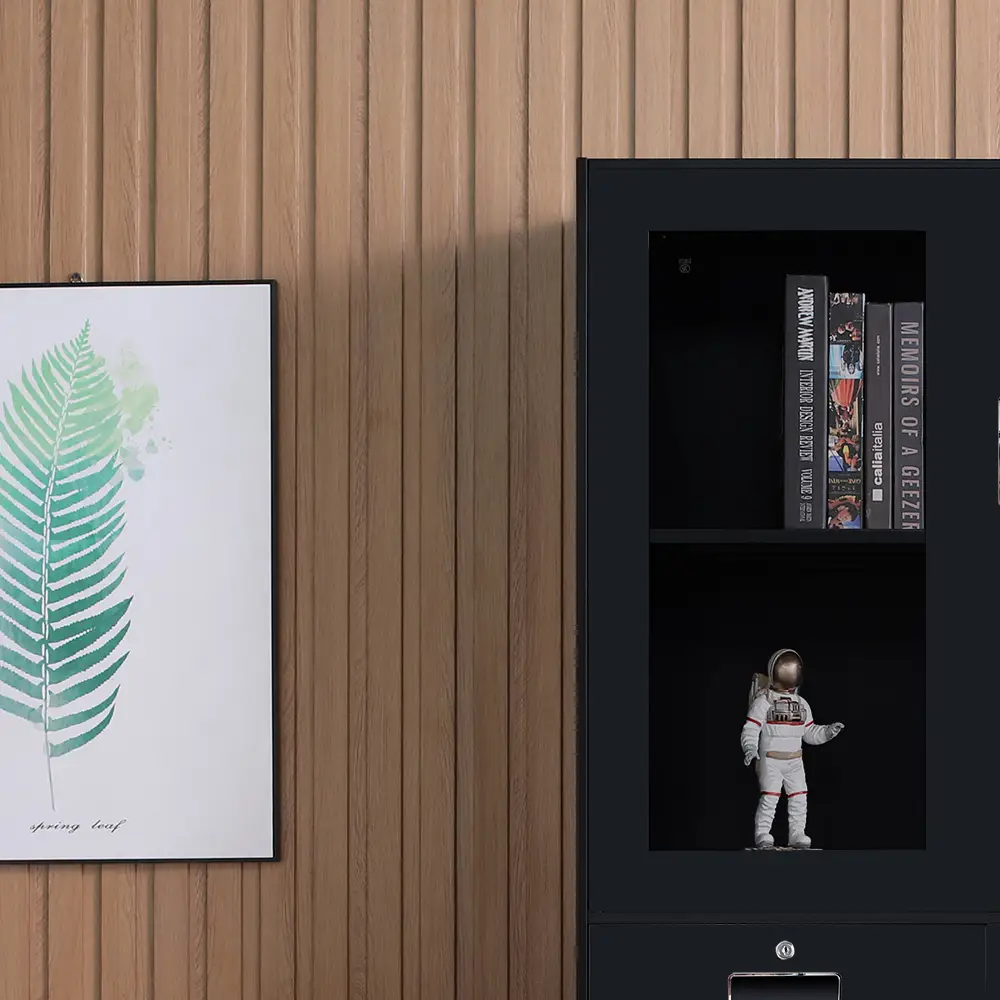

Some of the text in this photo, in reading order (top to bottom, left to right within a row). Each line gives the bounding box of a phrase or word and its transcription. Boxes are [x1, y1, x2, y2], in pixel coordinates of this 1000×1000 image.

[797, 287, 814, 326] ANDREW
[797, 327, 814, 361] MARTIN
[799, 369, 814, 403] INTERIOR
[799, 406, 814, 433] DESIGN
[900, 322, 920, 529] MEMOIRS OF A GEEZER
[872, 422, 883, 486] caliaitalia
[800, 468, 813, 494] VOLUME
[29, 820, 81, 834] spring
